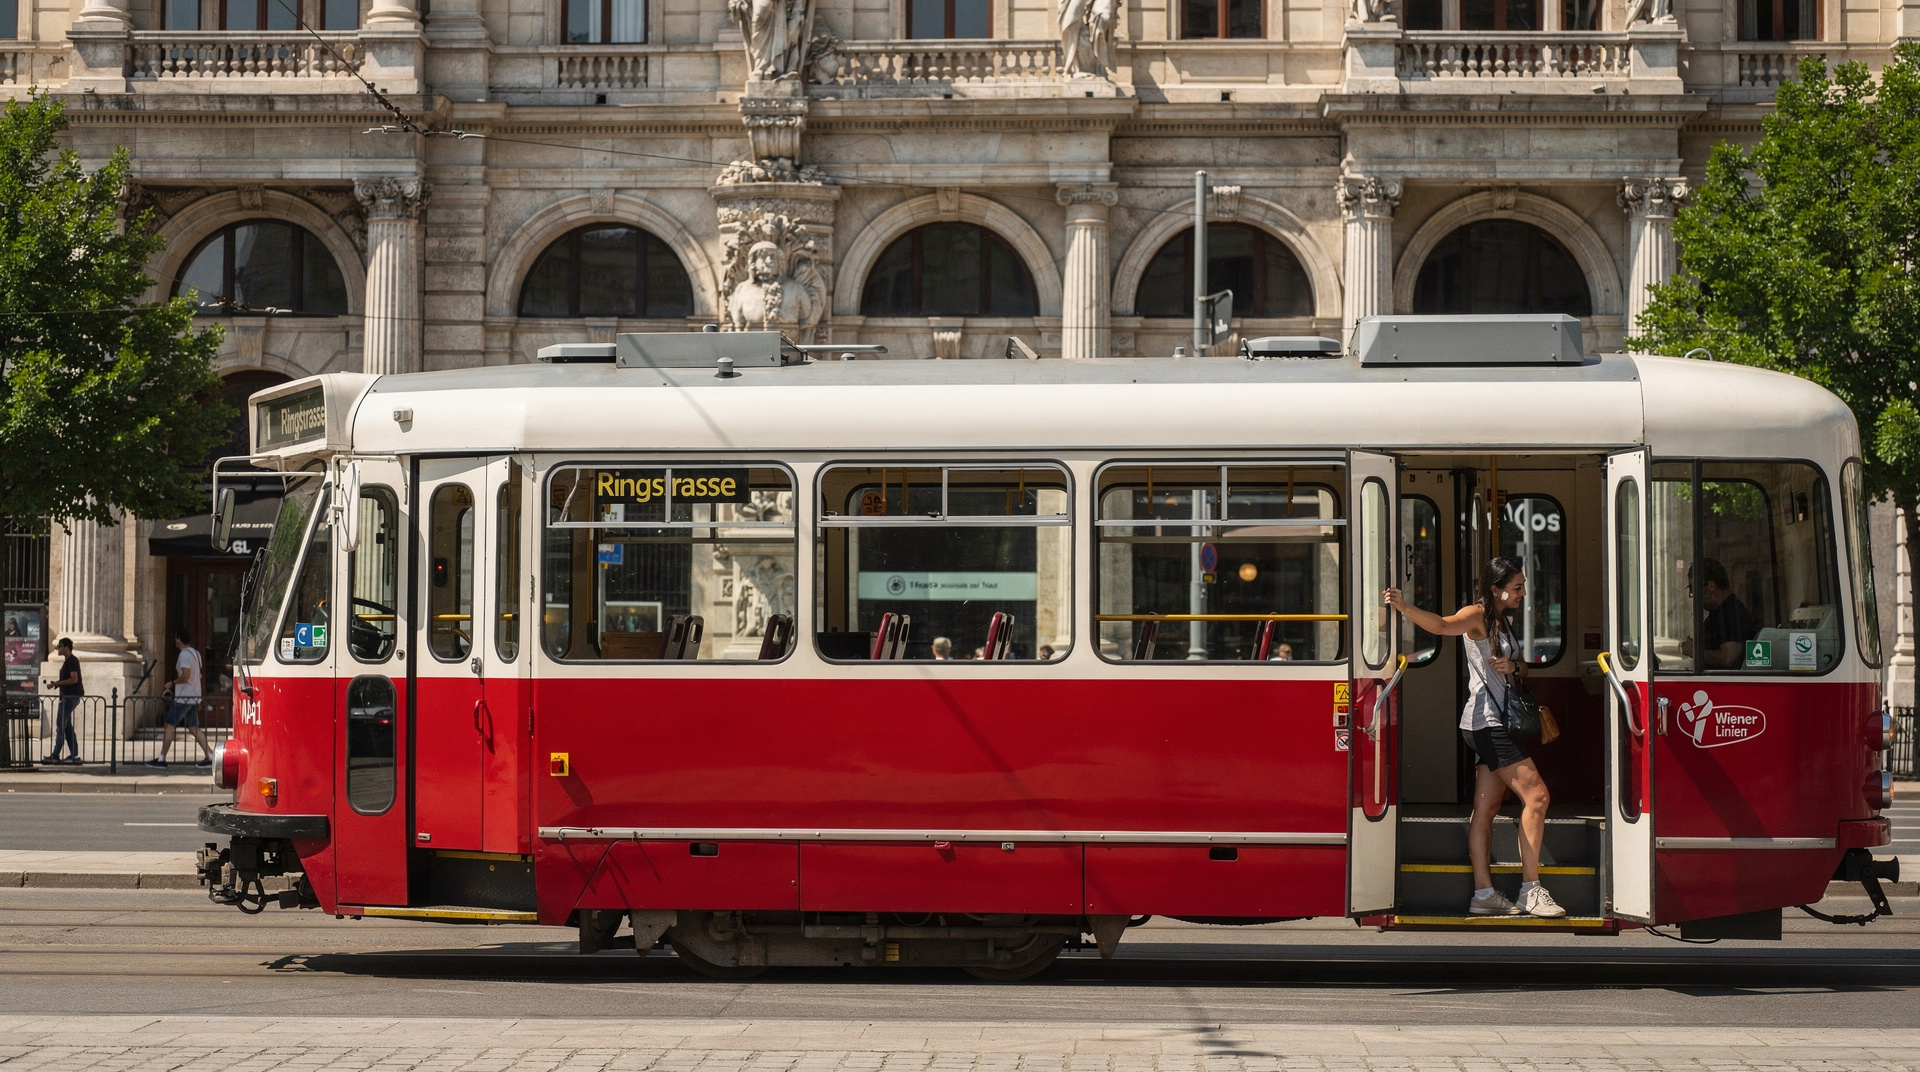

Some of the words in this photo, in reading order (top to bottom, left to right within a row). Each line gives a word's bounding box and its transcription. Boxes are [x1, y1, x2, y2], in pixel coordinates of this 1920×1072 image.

[265, 411, 271, 441] 1
[281, 405, 326, 441] Ringstrasse
[598, 472, 737, 503] Ringsrasse
[1715, 712, 1758, 725] Wiener
[1715, 725, 1748, 737] Linien
